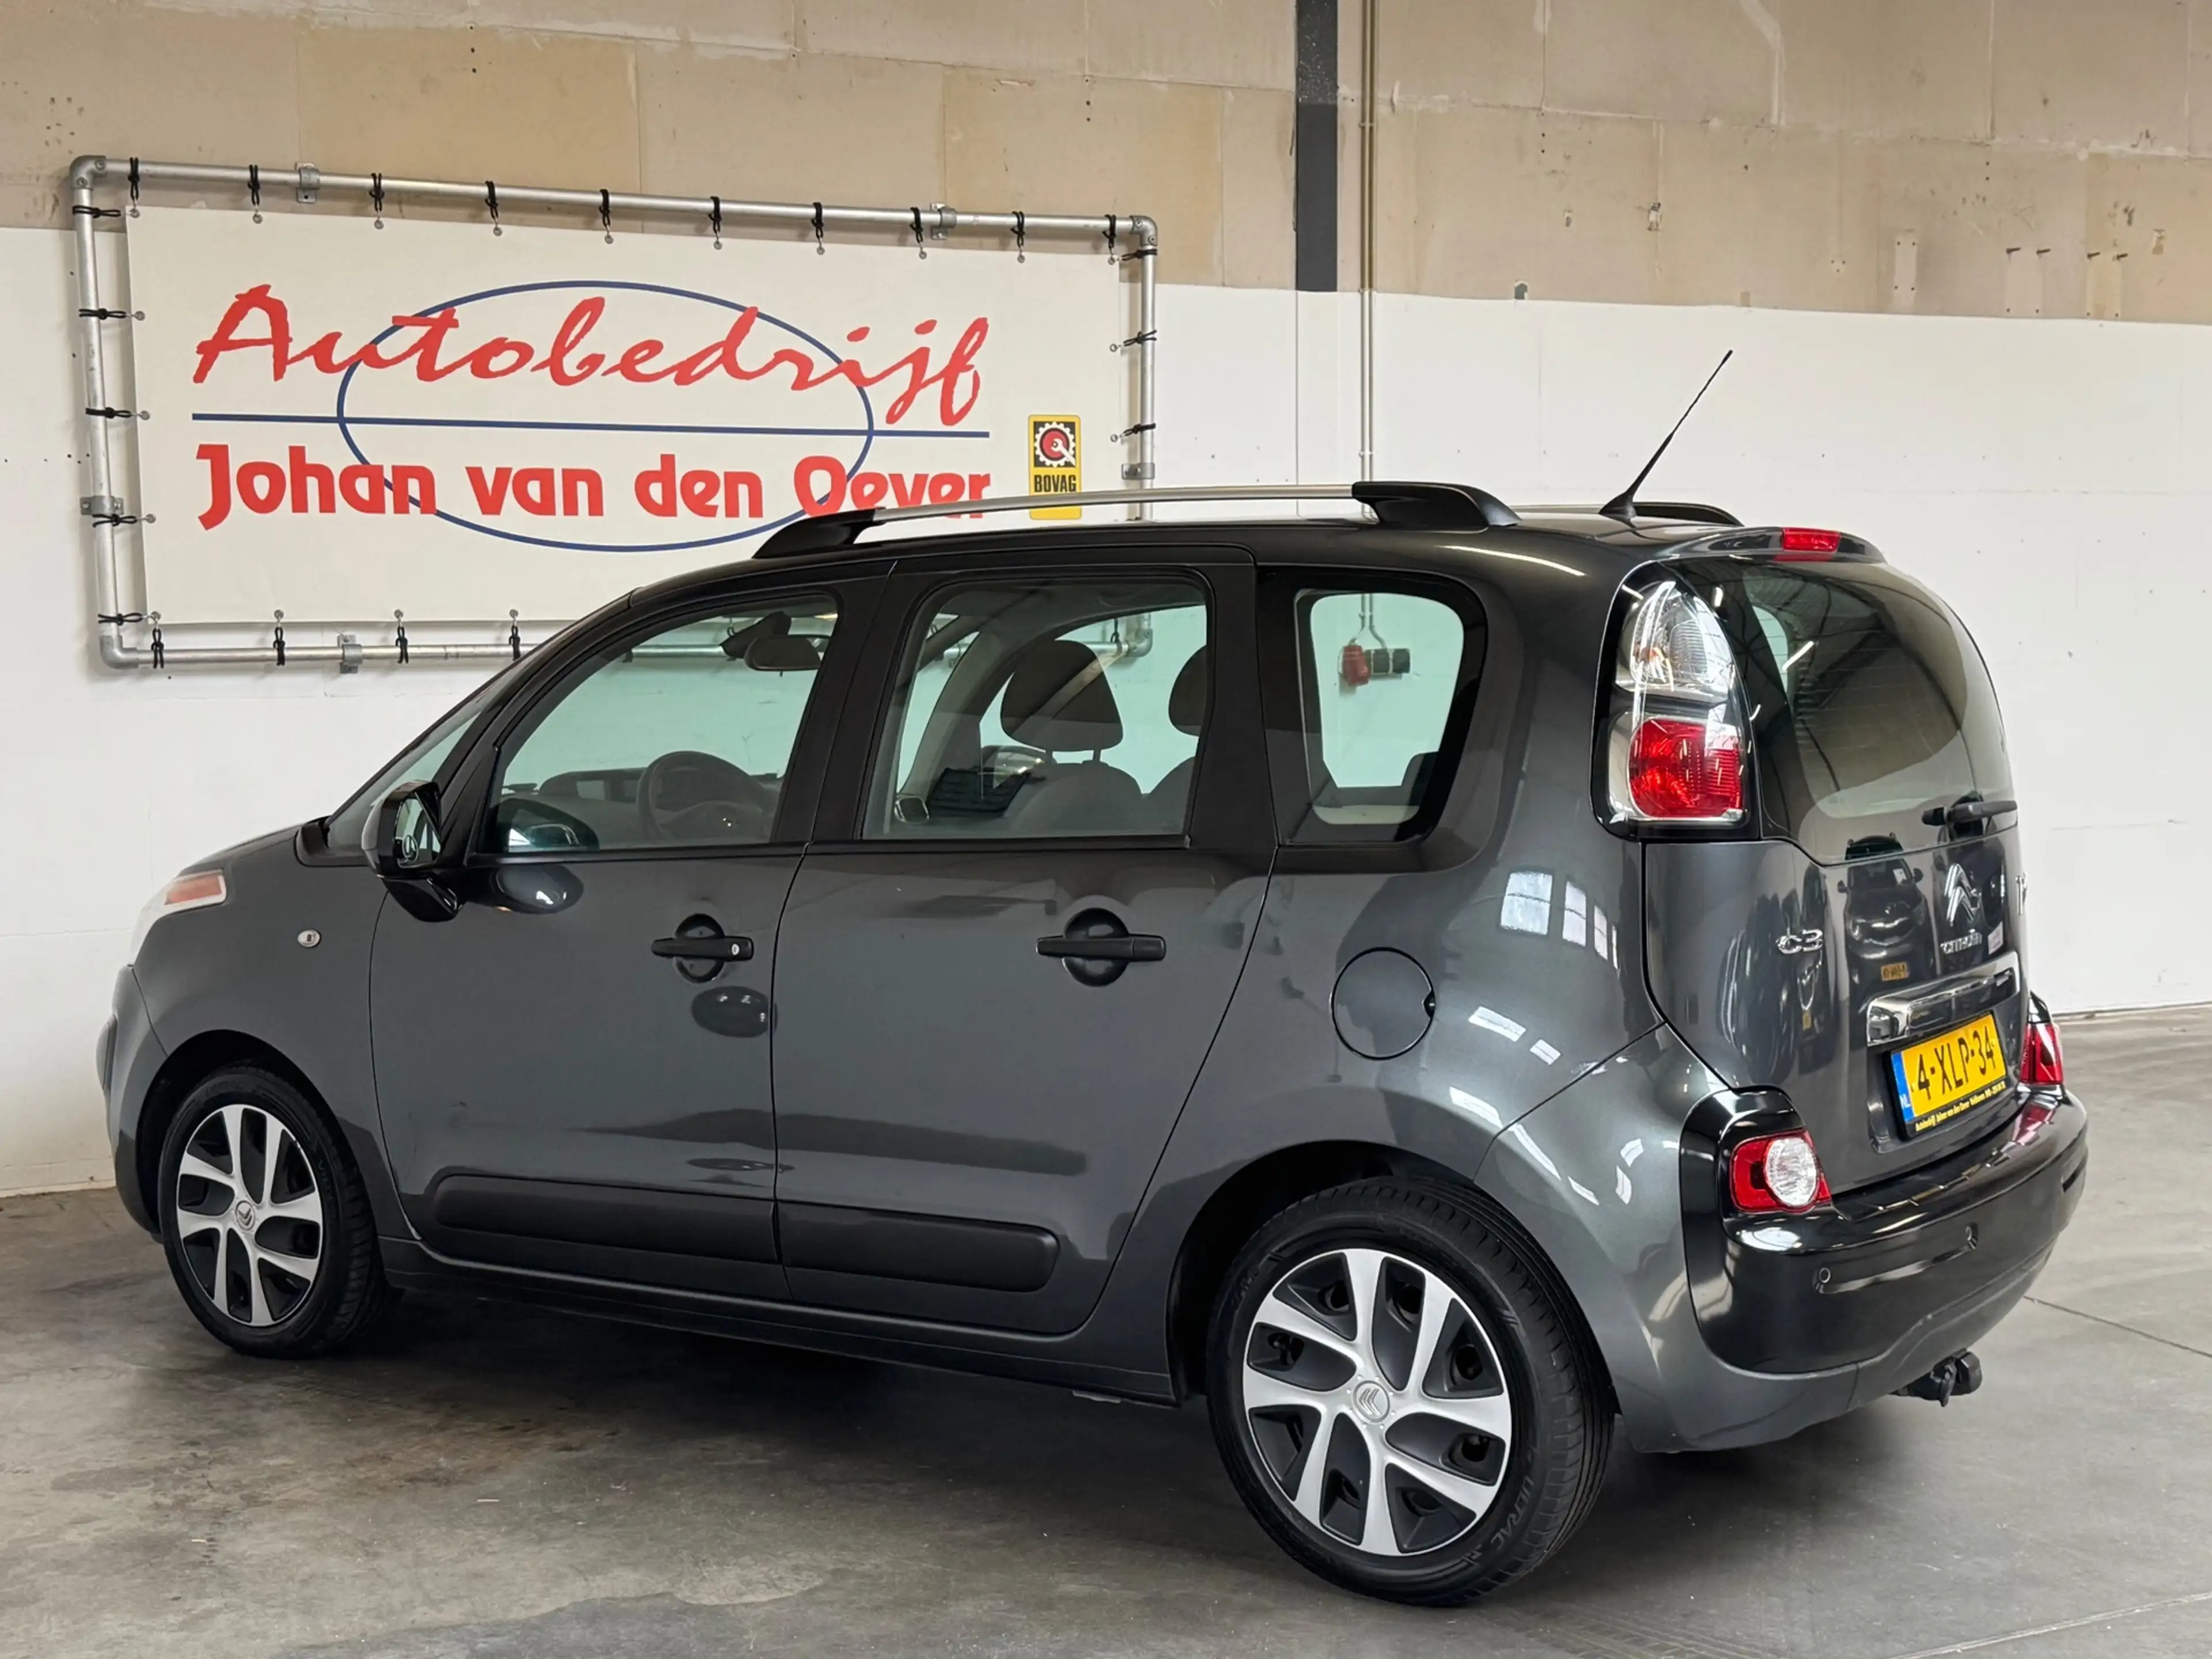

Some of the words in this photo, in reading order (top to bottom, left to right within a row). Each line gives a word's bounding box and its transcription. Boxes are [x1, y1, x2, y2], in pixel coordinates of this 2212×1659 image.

[192, 284, 988, 427] Autobedrijf
[196, 444, 437, 531] Johan
[465, 466, 604, 517] van
[635, 454, 763, 517] den
[794, 455, 991, 518] Oever
[1033, 474, 1077, 493] BOVAG
[1777, 929, 1823, 955] C3
[1917, 1025, 1996, 1101] 4-XLP-34
[1900, 1093, 1911, 1109] NL
